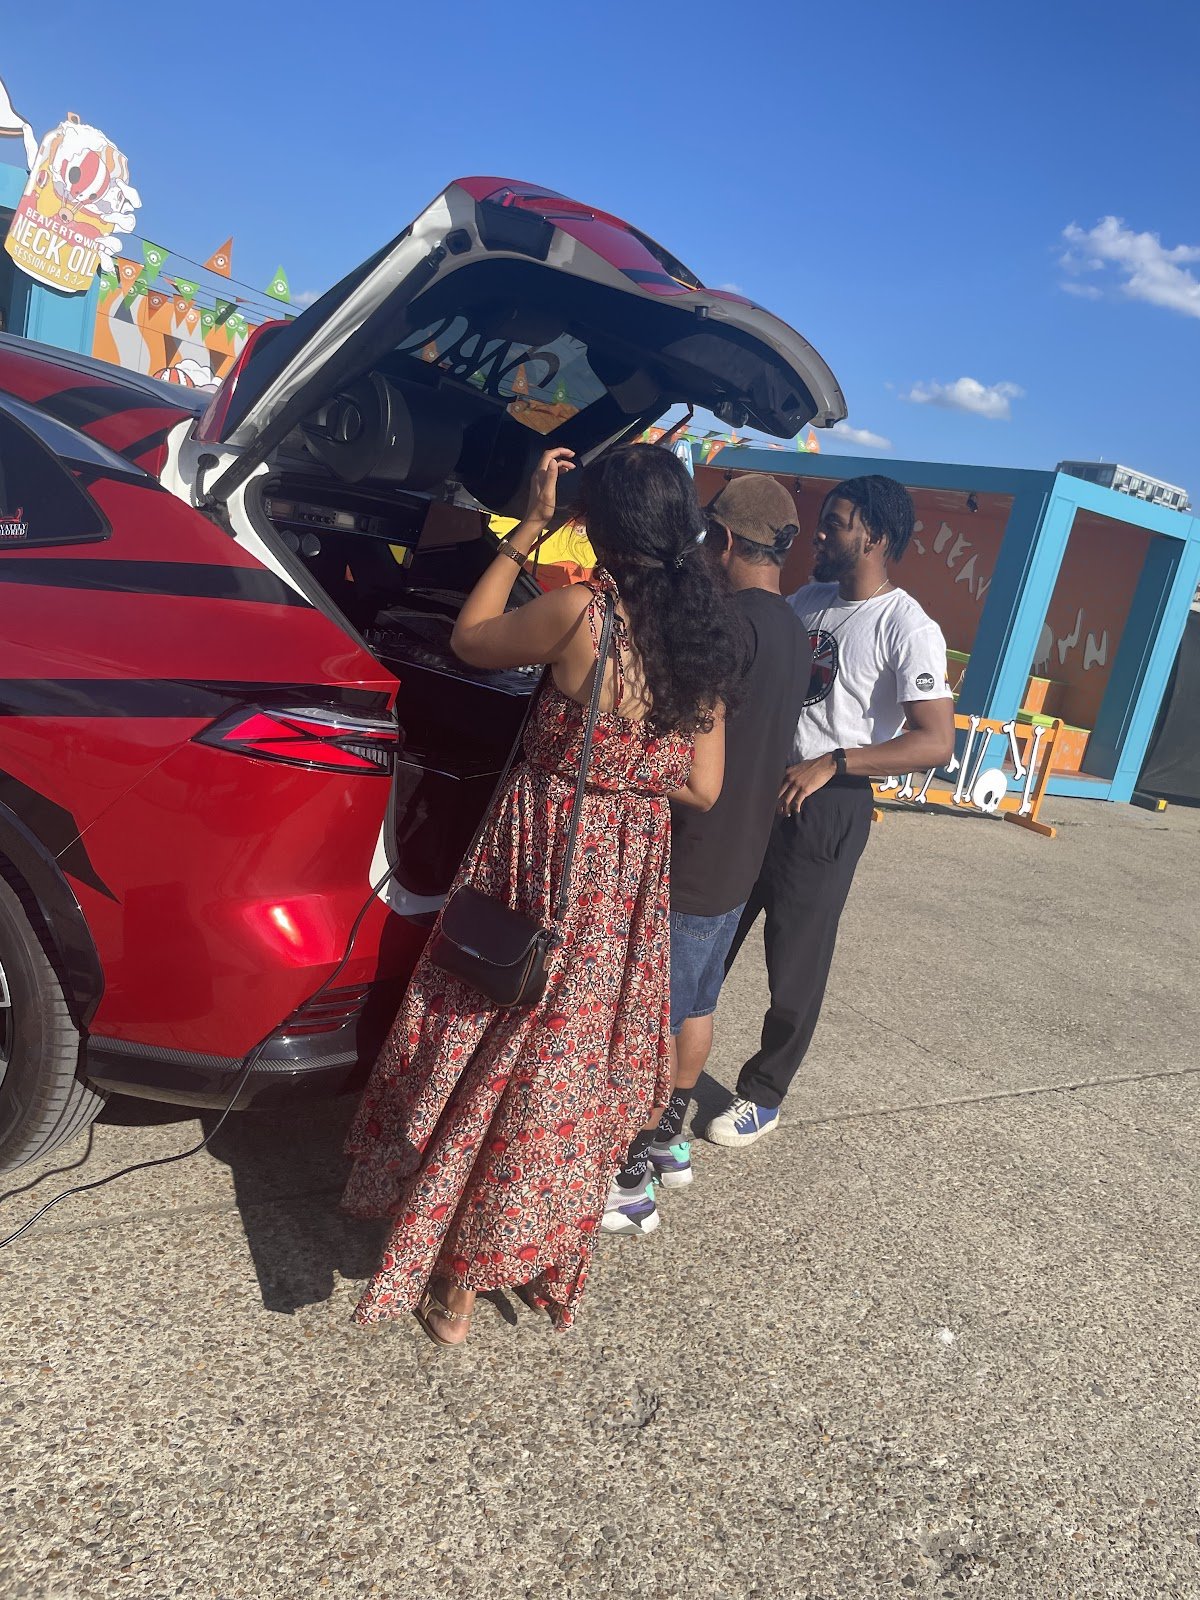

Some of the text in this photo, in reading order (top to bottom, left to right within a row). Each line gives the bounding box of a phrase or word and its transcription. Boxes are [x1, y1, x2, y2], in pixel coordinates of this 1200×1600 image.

[12, 213, 67, 265] NECK
[67, 245, 97, 277] OIL
[26, 207, 98, 251] BEAVERTOWN
[13, 244, 46, 271] SESSION
[47, 264, 61, 279] IPA
